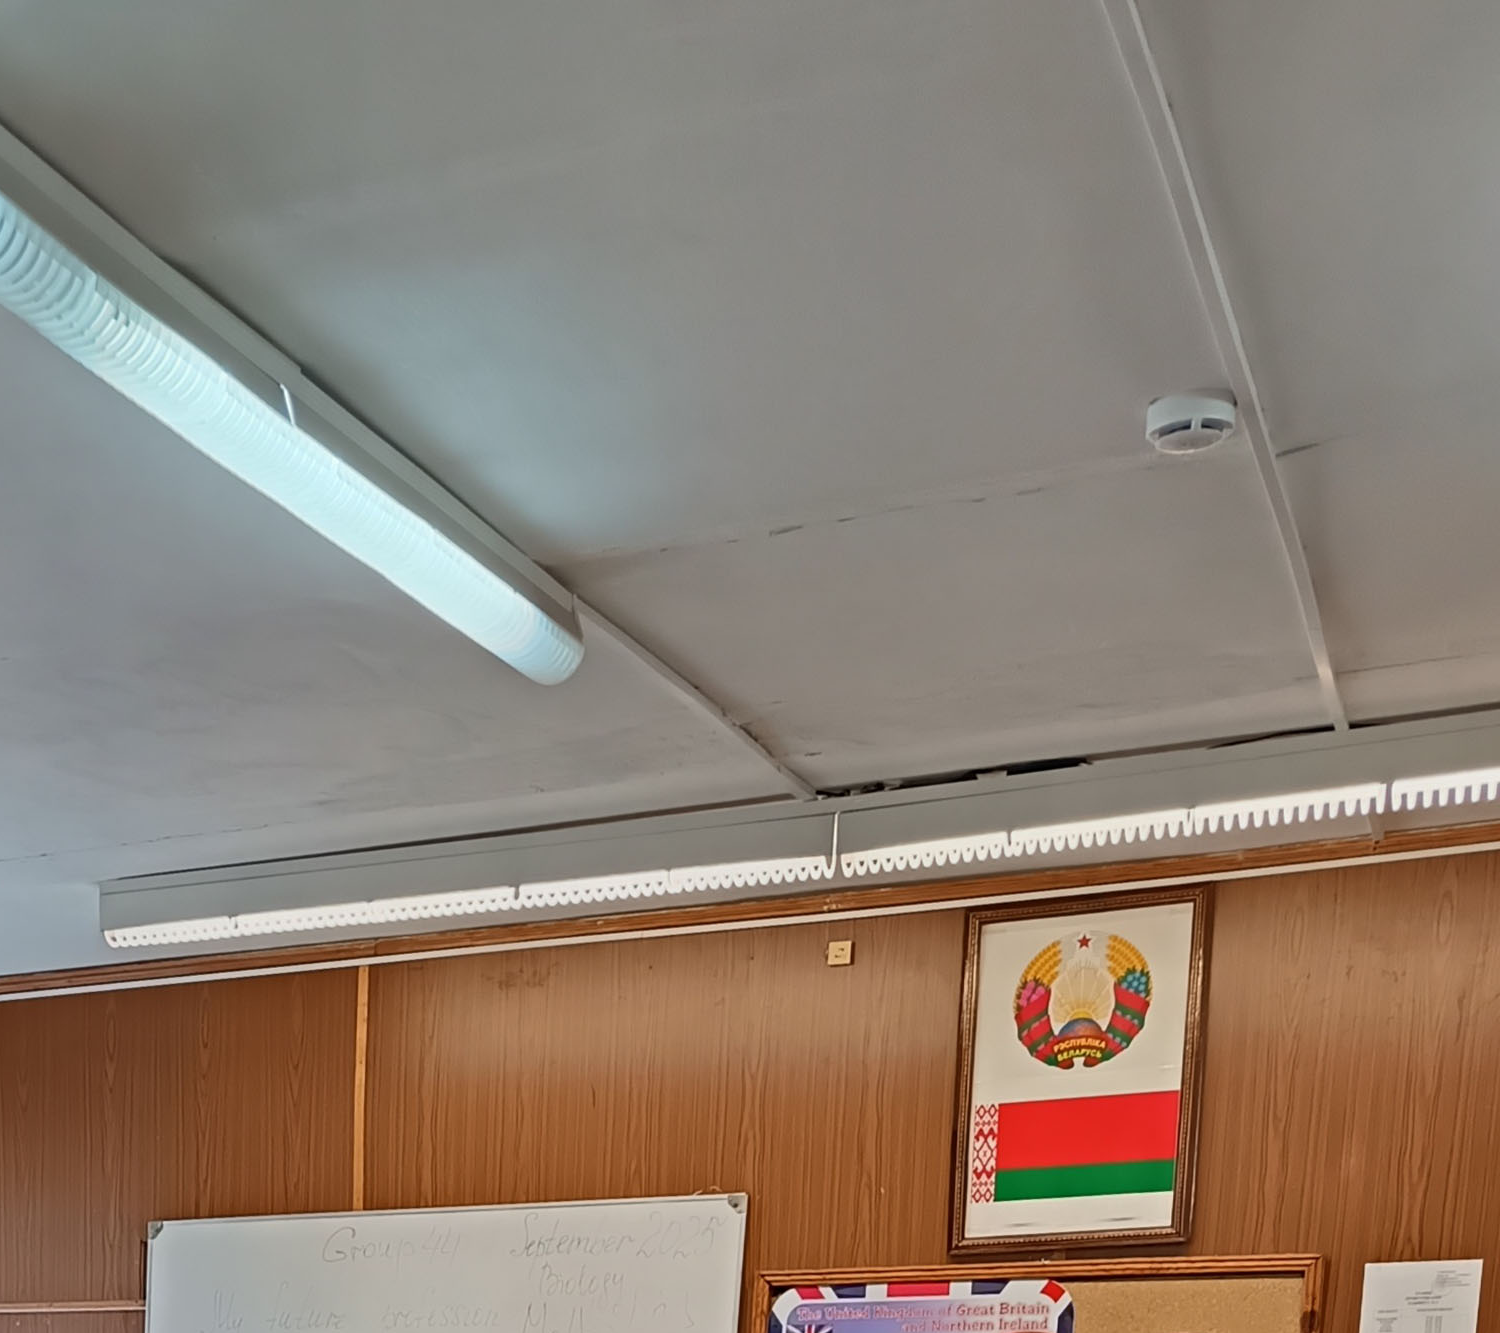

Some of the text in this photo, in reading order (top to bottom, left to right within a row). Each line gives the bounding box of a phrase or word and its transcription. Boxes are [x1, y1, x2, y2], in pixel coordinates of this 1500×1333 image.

[322, 1226, 417, 1273] Group
[510, 1212, 636, 1280] September
[265, 1280, 347, 1332] future
[796, 1306, 822, 1322] The
[825, 1305, 869, 1321] United
[956, 1304, 995, 1317] Great
[999, 1303, 1050, 1315] Britain
[902, 1318, 1049, 1333] and Northern Ireland
